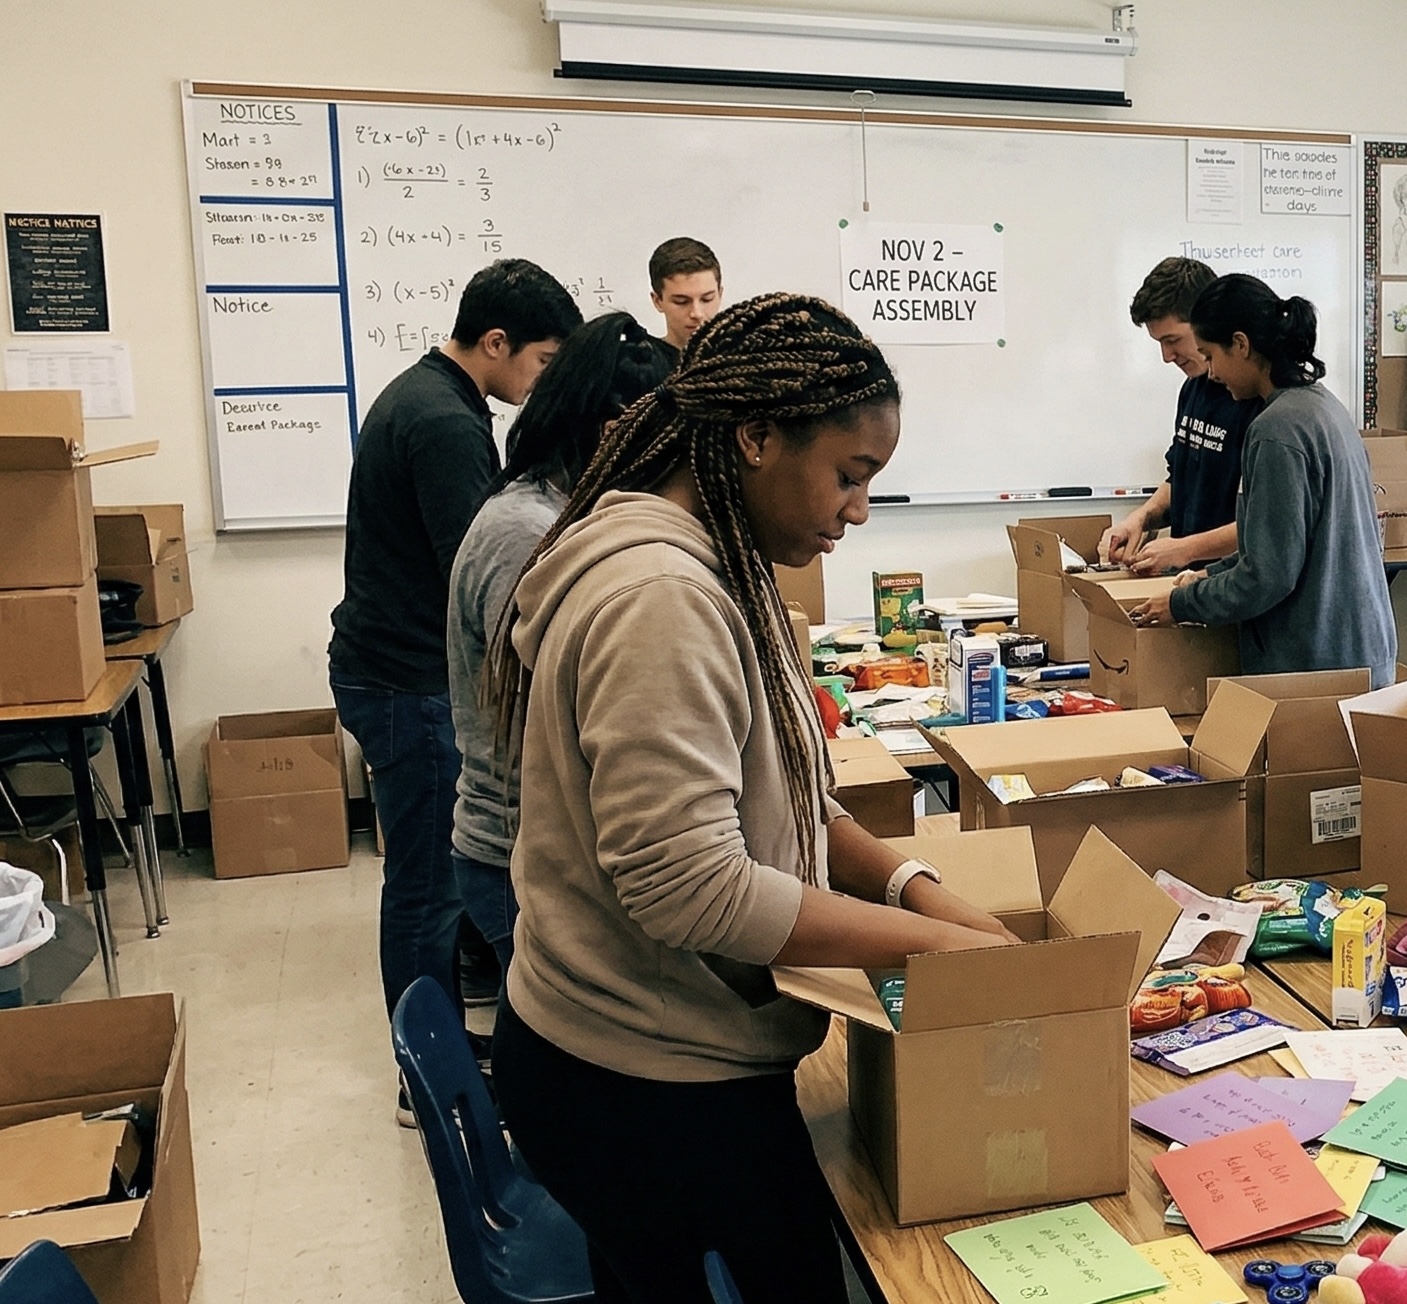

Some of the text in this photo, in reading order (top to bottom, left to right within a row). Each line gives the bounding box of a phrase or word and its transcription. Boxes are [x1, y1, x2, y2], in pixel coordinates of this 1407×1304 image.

[220, 103, 296, 121] NOTICES
[202, 132, 240, 148] Mart
[477, 168, 490, 180] 2
[480, 188, 491, 202] 3
[1286, 199, 1317, 214] days
[482, 218, 495, 232] 3
[484, 241, 502, 253] 15
[882, 239, 925, 261] NOV
[933, 240, 944, 261] 2
[849, 269, 998, 293] CARE PACKAGE
[212, 296, 274, 314] Notice
[872, 299, 977, 322] ASSEMBLY
